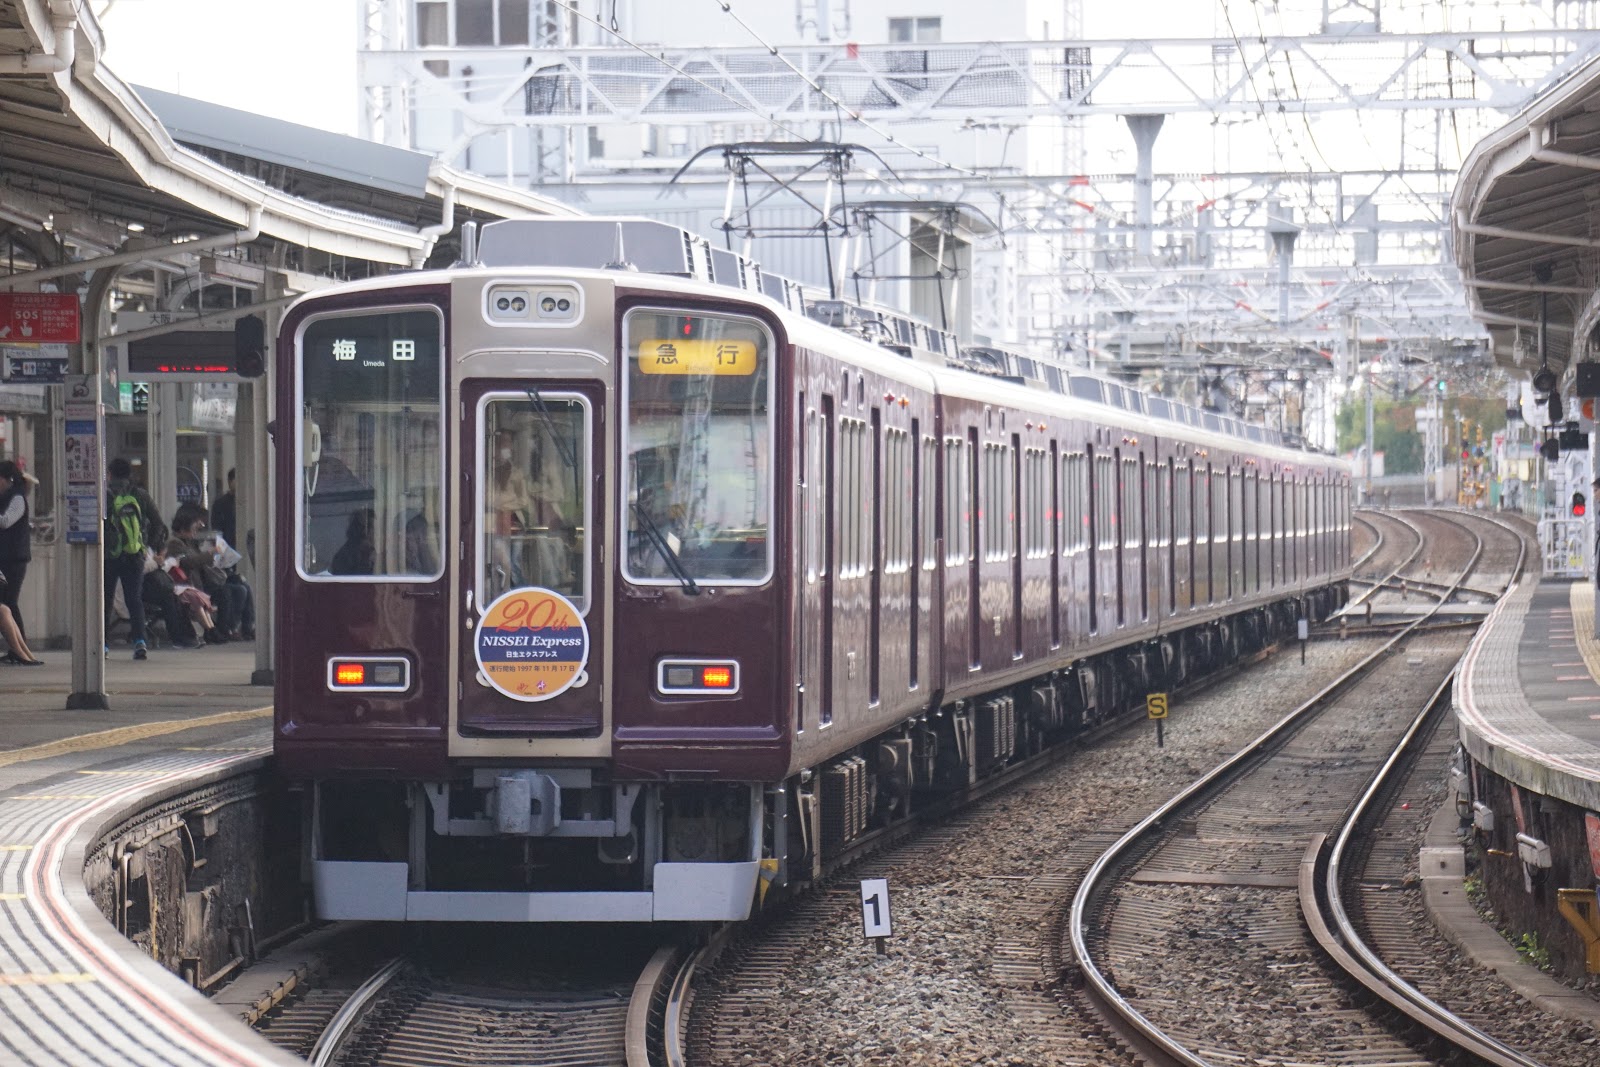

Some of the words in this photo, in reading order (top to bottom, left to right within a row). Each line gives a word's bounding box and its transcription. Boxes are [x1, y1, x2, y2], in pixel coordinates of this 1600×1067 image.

[15, 310, 38, 320] SOS
[149, 313, 171, 325] 大阪
[332, 339, 415, 361] 梅田
[656, 343, 739, 365] 急行
[496, 599, 569, 632] 20th
[483, 636, 528, 646] NISSEI
[532, 636, 581, 648] Express
[506, 650, 558, 658] 日生エクスプレス
[1149, 697, 1165, 716] S
[864, 893, 881, 927] 1
